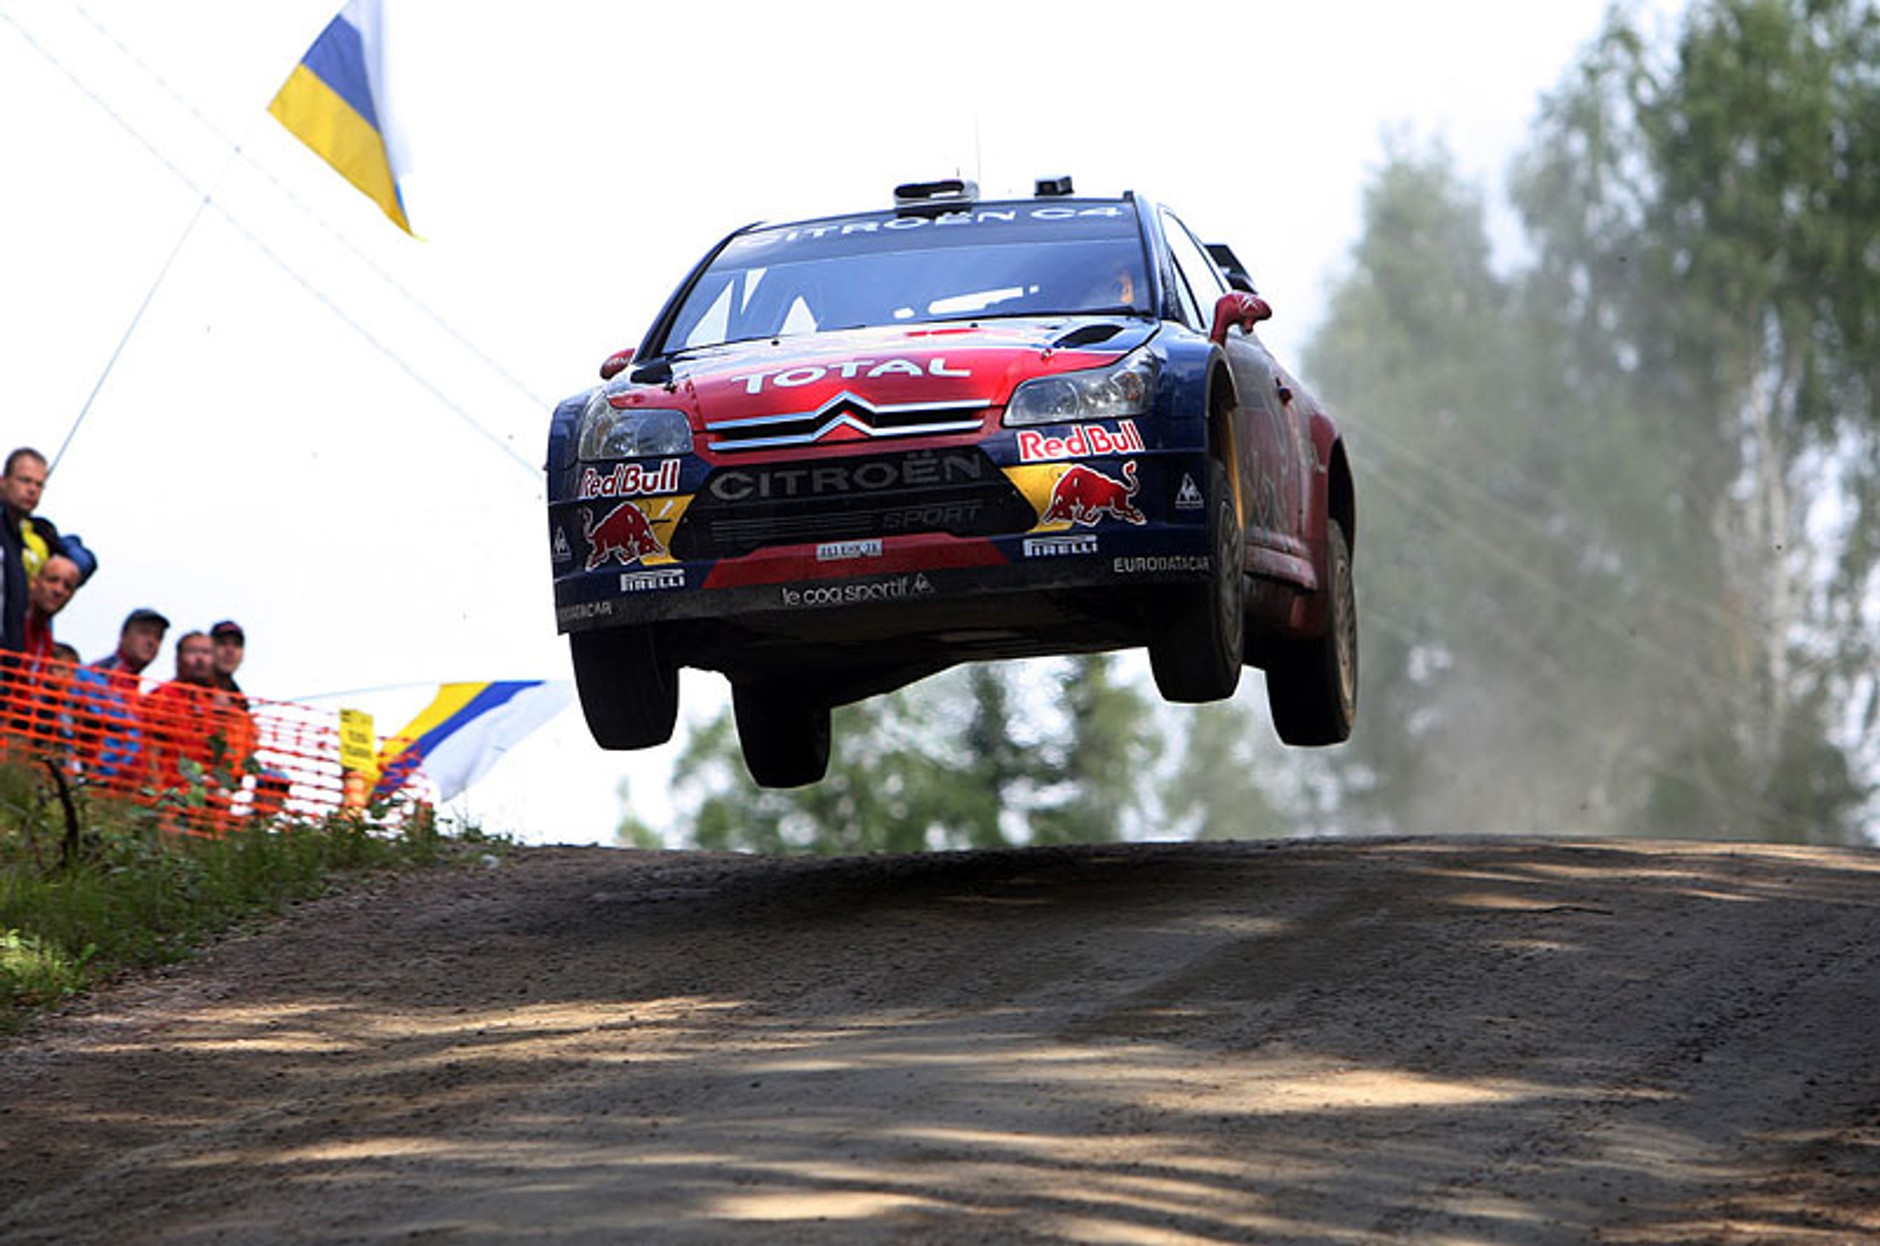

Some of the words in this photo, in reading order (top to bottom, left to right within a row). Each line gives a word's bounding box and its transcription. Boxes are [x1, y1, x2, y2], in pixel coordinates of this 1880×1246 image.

[1030, 206, 1123, 221] C4
[730, 357, 972, 394] TOTAL
[1017, 424, 1089, 461] Red
[1084, 419, 1146, 456] Bull
[578, 463, 624, 499] Red
[620, 459, 681, 495] Bull
[709, 449, 983, 501] CITROËN
[882, 503, 984, 529] SPORT
[1022, 534, 1098, 558] PIRELLI
[620, 568, 686, 592] PIRELLI
[781, 586, 801, 606] le
[803, 586, 843, 605] coq
[845, 575, 908, 602] sportif
